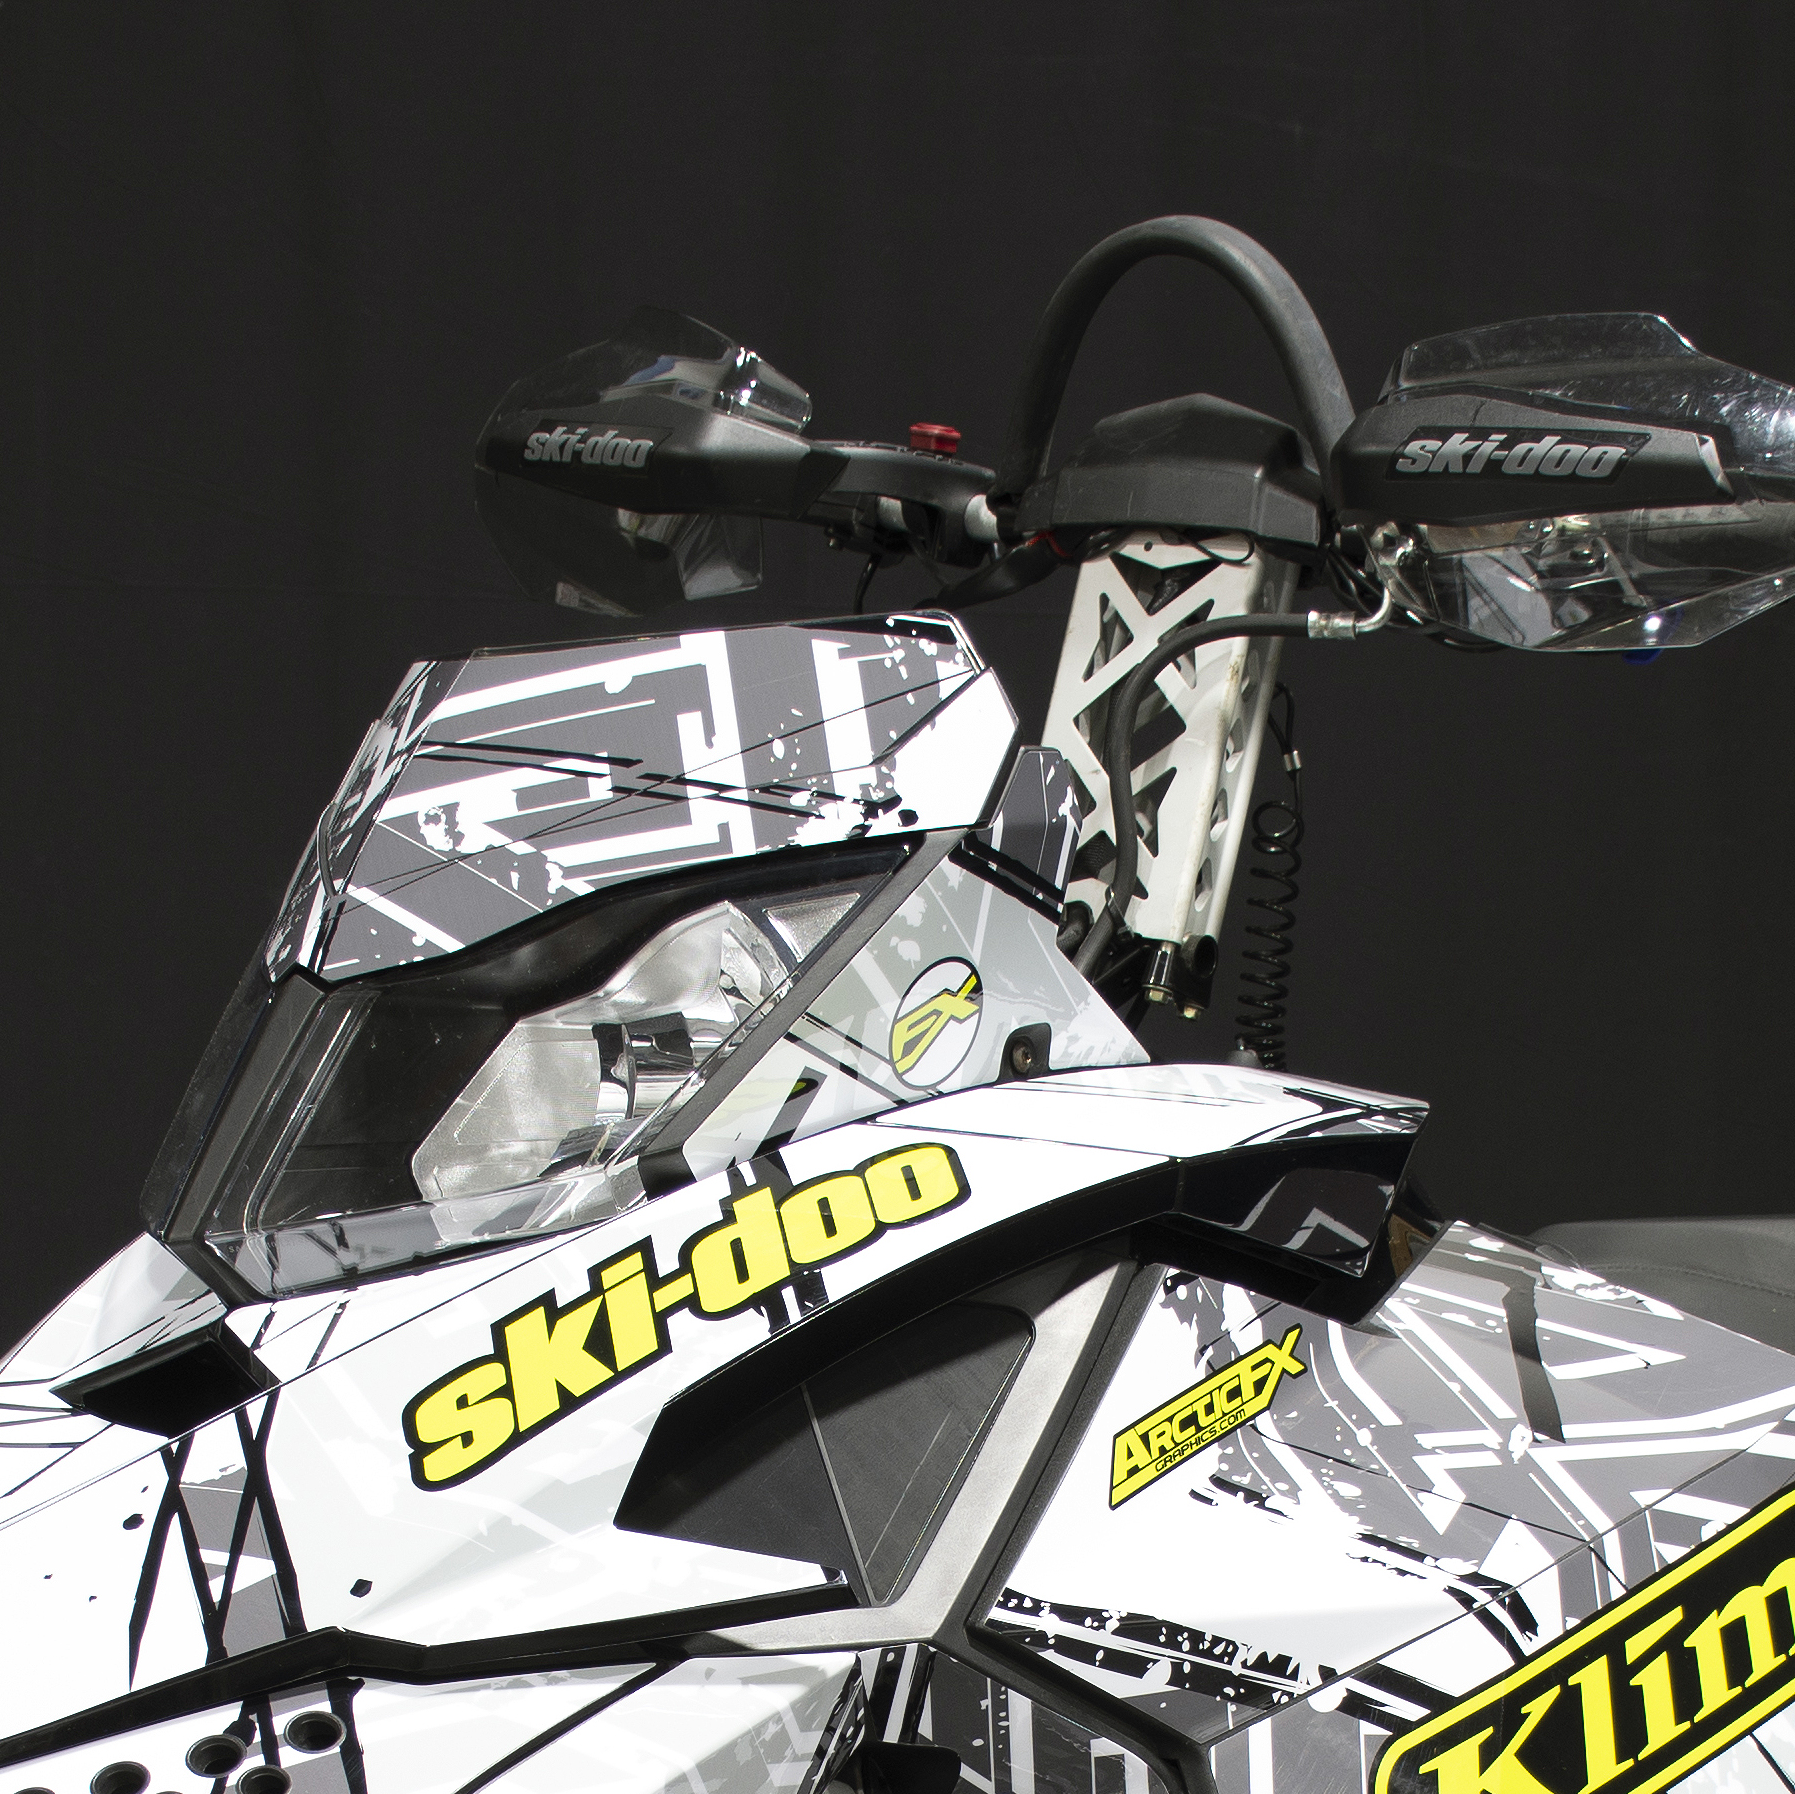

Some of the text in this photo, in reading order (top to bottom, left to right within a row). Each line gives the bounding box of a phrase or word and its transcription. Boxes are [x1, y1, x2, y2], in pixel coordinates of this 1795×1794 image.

[525, 426, 653, 468] ski-doo
[1395, 433, 1627, 476] ski-doo
[414, 1145, 961, 1483] ski-doo
